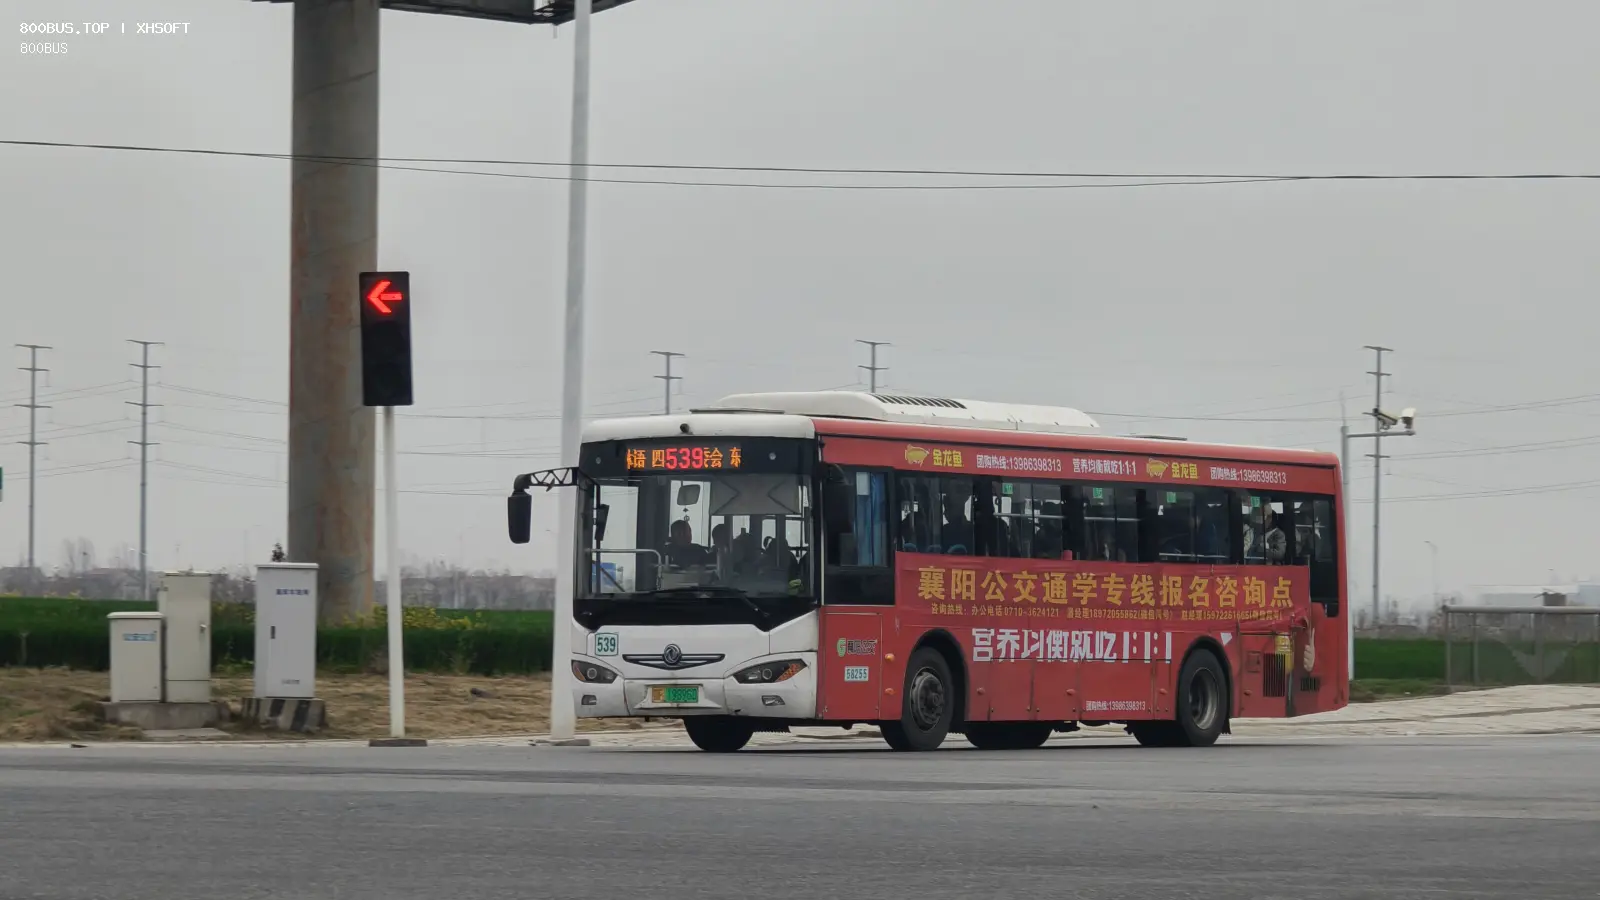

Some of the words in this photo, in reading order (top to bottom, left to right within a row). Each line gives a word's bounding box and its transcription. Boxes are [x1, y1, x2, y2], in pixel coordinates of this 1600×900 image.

[665, 447, 704, 470] 539
[933, 448, 964, 468] 金龙鱼
[1171, 462, 1199, 480] 金龙鱼
[918, 566, 1294, 609] 襄阳公交通学专线报名咨询点
[596, 637, 616, 652] 539
